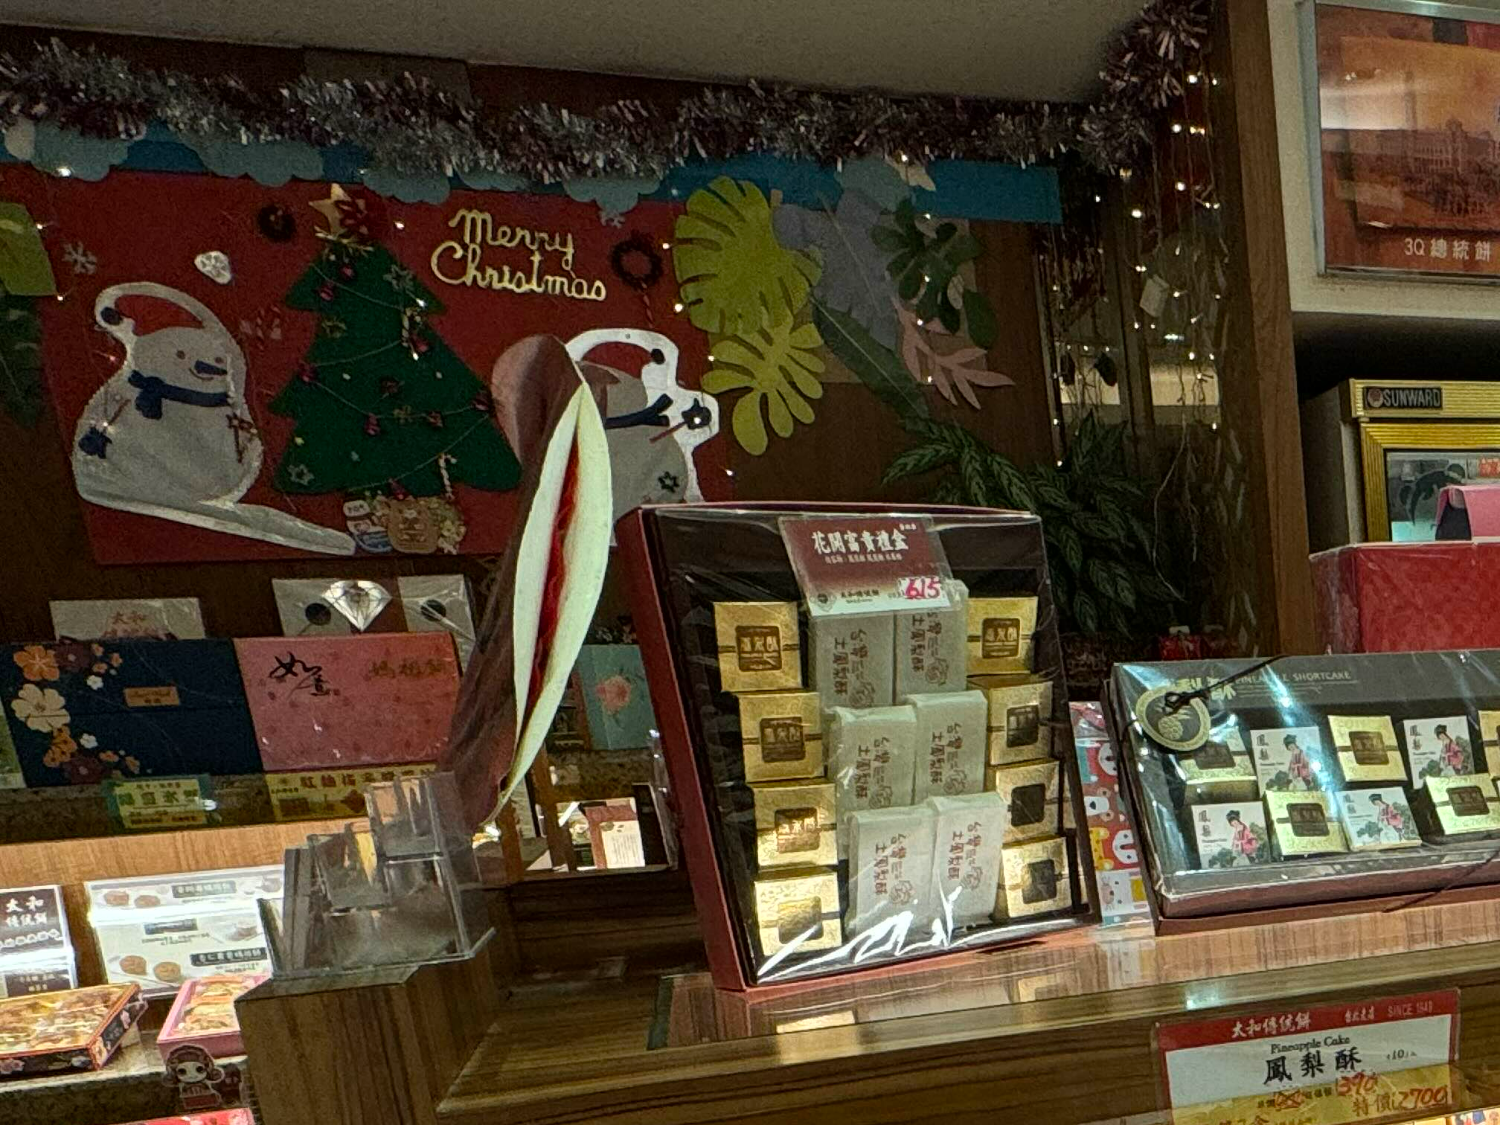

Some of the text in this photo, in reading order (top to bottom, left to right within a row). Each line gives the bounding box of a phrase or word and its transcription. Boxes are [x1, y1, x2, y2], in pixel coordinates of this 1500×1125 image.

[449, 209, 574, 274] Merry
[430, 242, 607, 303] Christmas
[1383, 387, 1441, 409] SUNWARD
[1293, 671, 1352, 681] SHORTCAKE
[1387, 1004, 1412, 1018] SINCE
[1270, 1035, 1352, 1055] Pineapple Cake
[1264, 1046, 1363, 1086] 鳳梨酥
